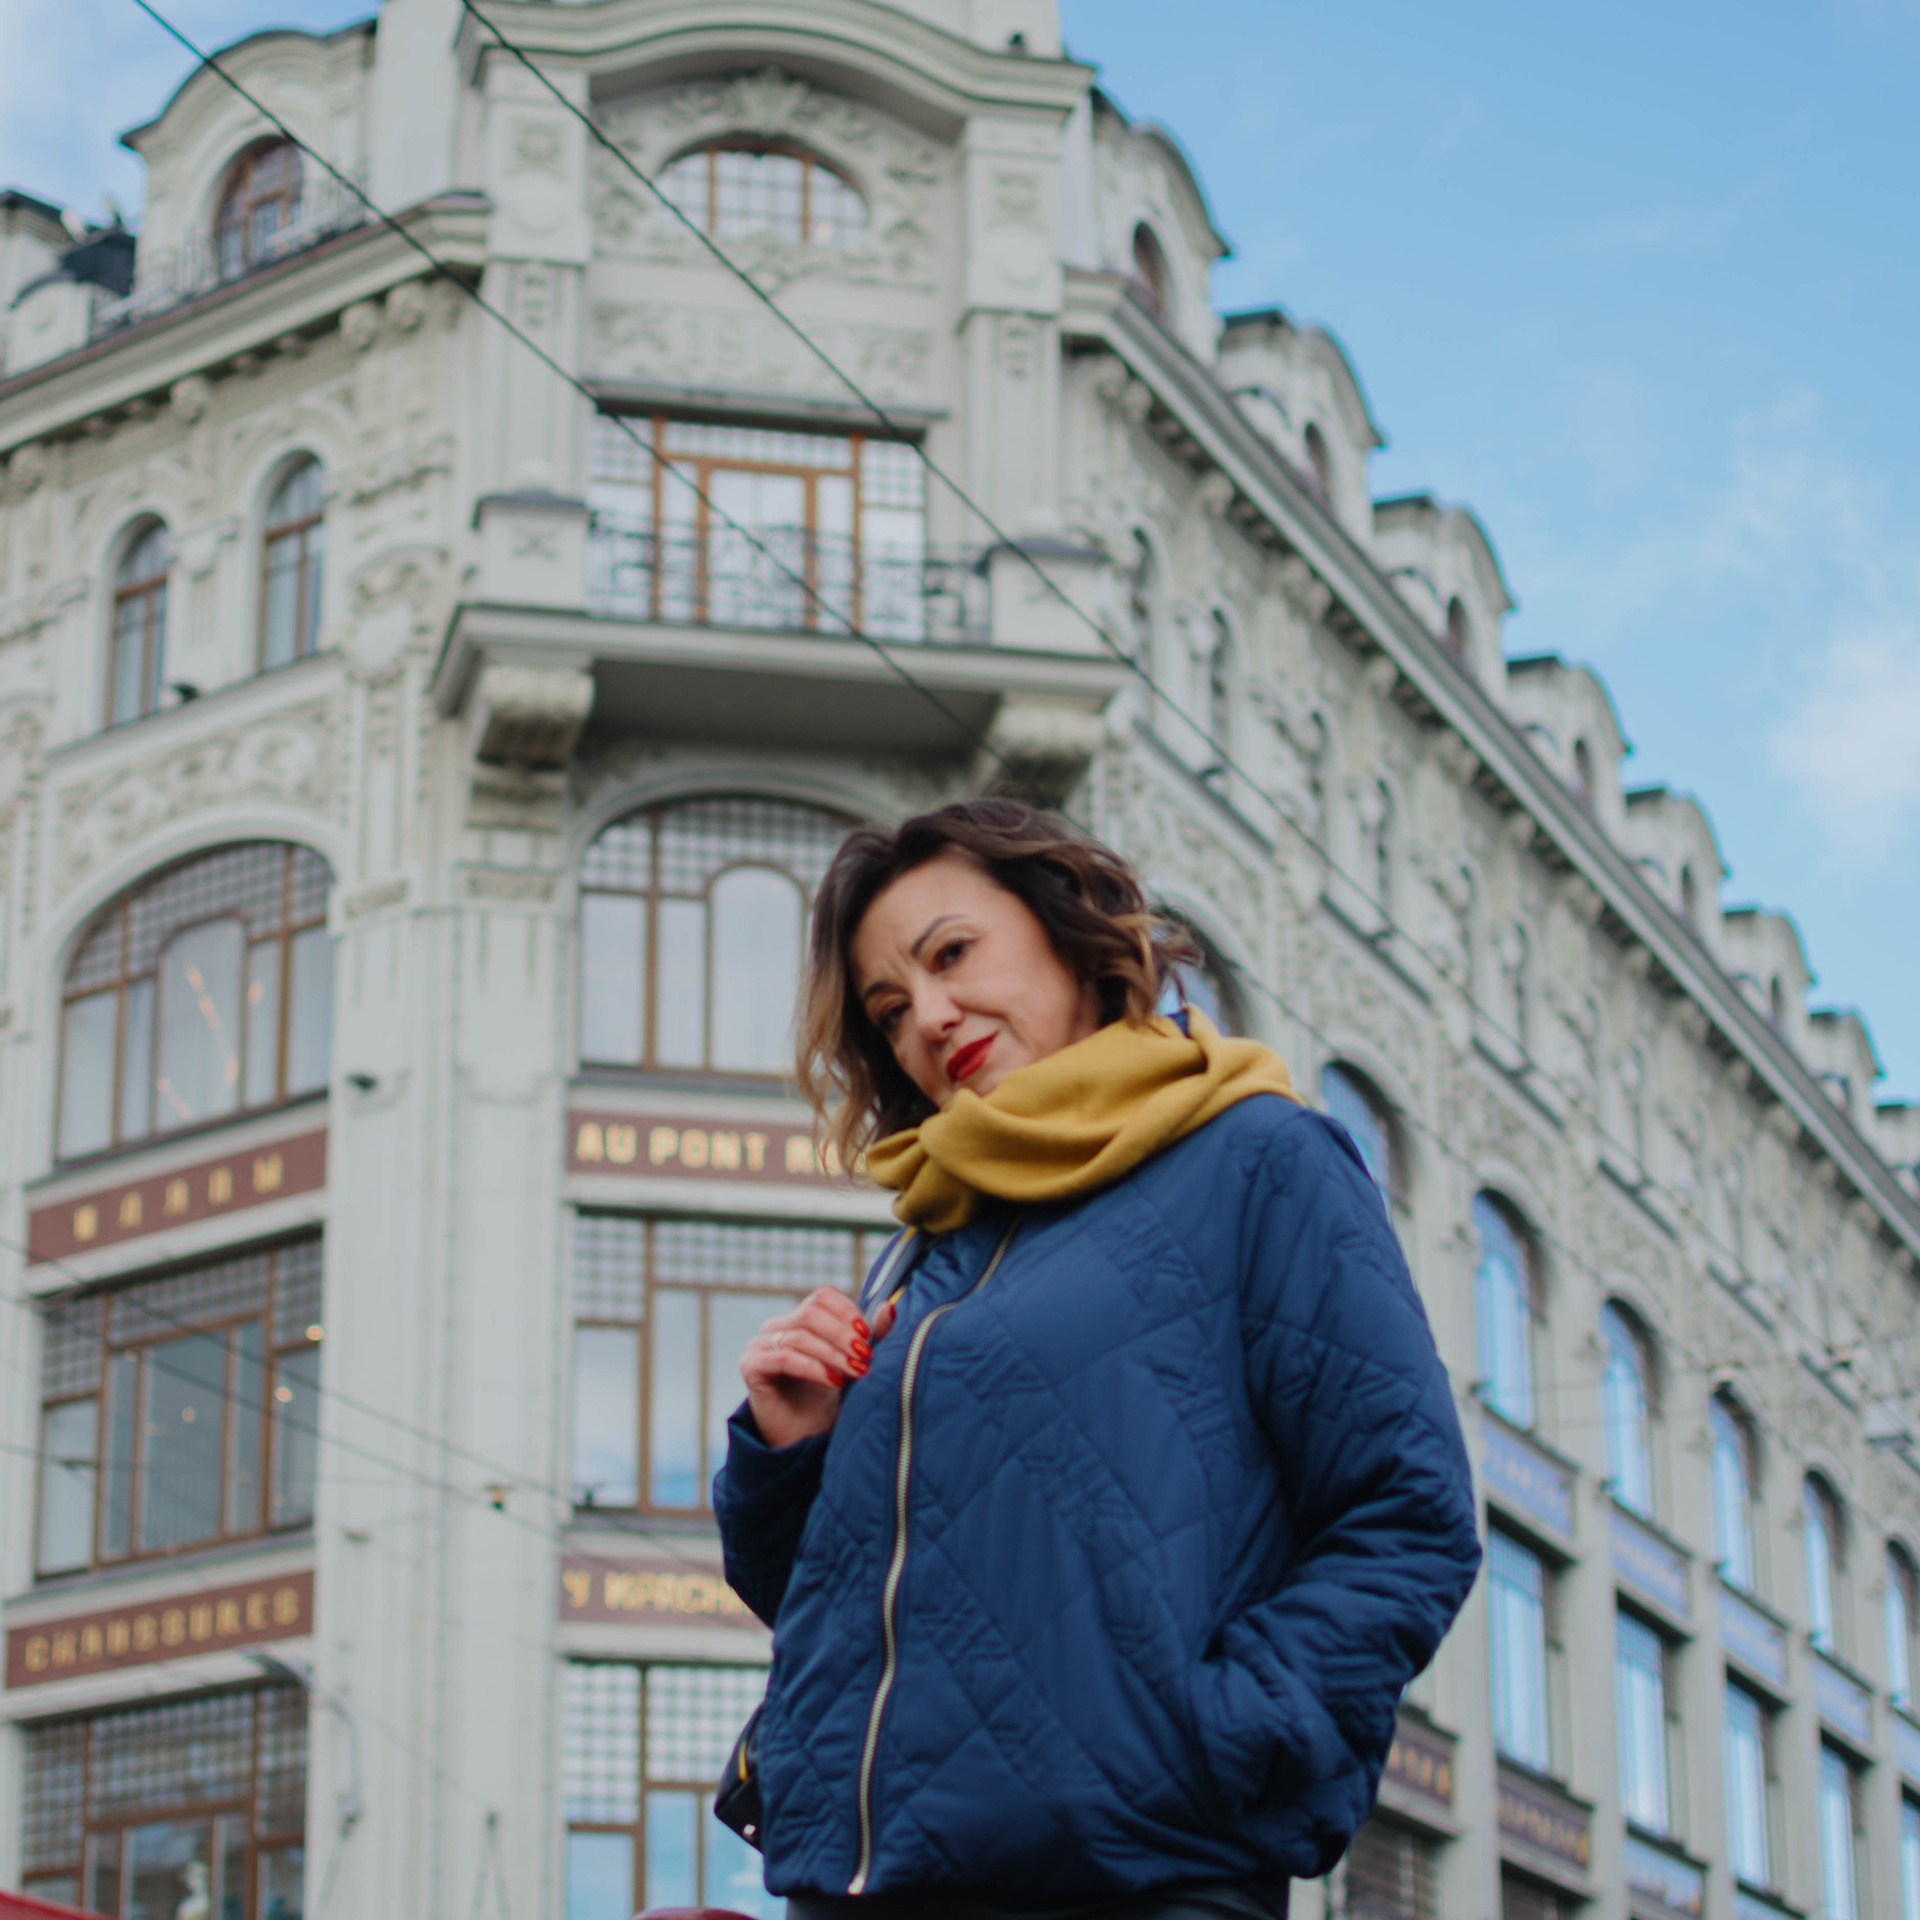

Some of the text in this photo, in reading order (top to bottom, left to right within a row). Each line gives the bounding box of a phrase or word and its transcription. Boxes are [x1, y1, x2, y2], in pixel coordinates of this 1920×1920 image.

[575, 1121, 638, 1165] AU
[649, 1126, 770, 1173] PONT
[24, 1587, 300, 1673] CHAUSSURES
